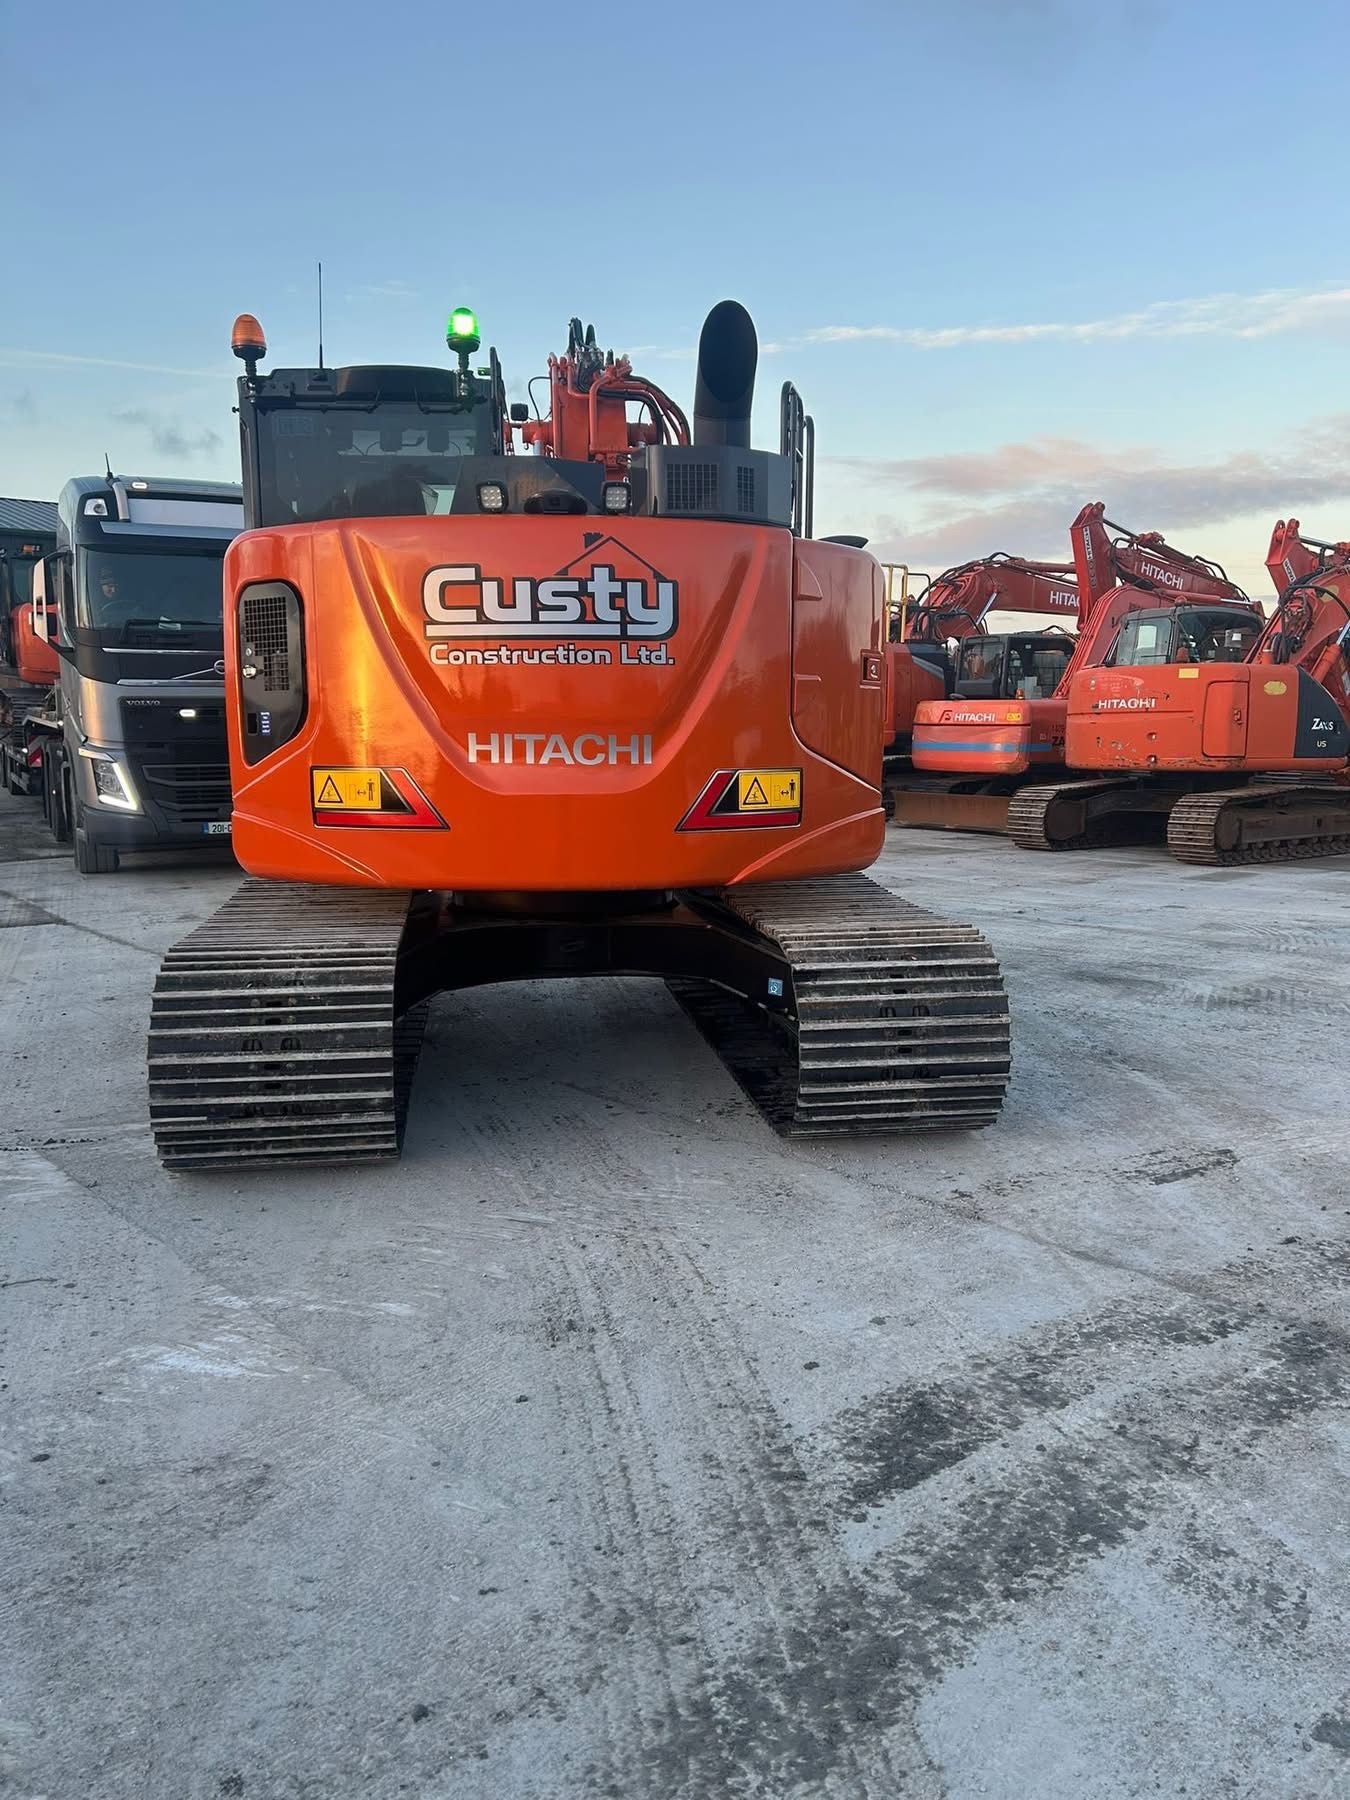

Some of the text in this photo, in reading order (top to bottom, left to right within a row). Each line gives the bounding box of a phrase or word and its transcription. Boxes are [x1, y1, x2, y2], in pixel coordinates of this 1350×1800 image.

[1141, 562, 1183, 590] HITACHI
[422, 564, 678, 640] Custy
[429, 643, 675, 665] Construction Ltd.
[1098, 698, 1156, 709] HITACHI
[954, 713, 995, 722] HITACHI
[467, 732, 653, 766] HITACHI
[1316, 740, 1327, 748] US
